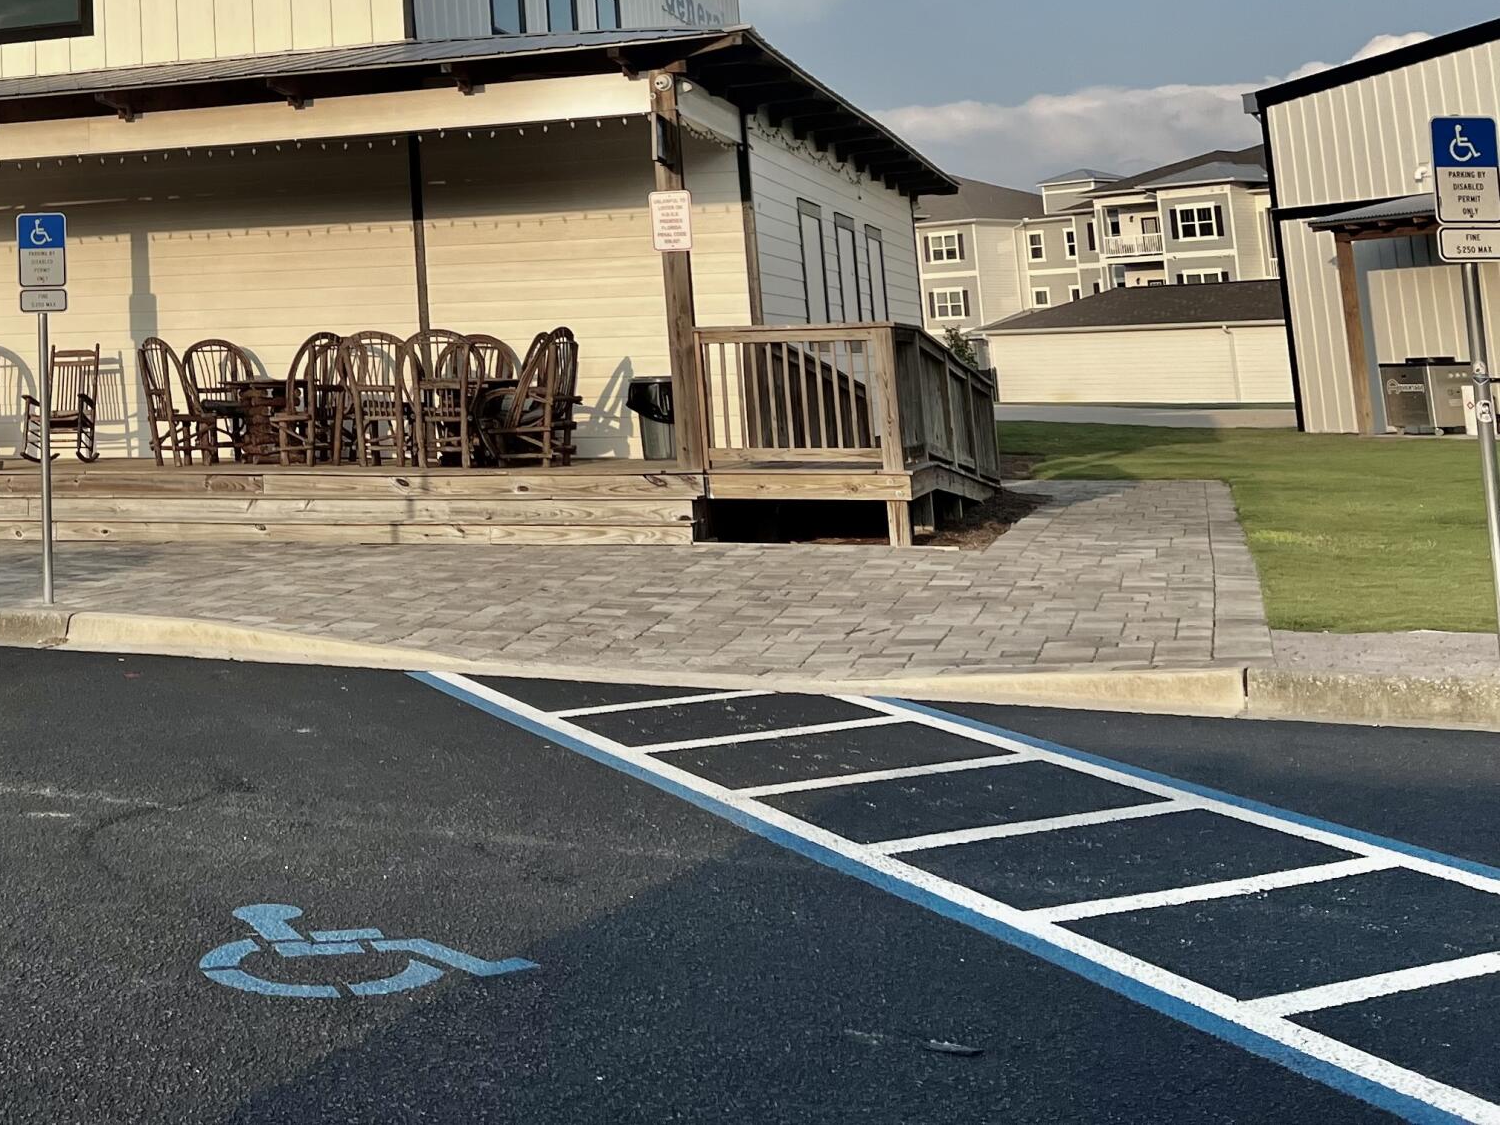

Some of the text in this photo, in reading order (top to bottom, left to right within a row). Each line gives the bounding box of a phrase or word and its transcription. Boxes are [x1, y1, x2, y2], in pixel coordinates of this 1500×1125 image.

[1453, 183, 1484, 191] DISABLED
[1457, 195, 1481, 203] PERMIT
[1462, 207, 1479, 215] ONLY
[1466, 233, 1481, 241] FINE
[1456, 246, 1492, 254] $250 MAX
